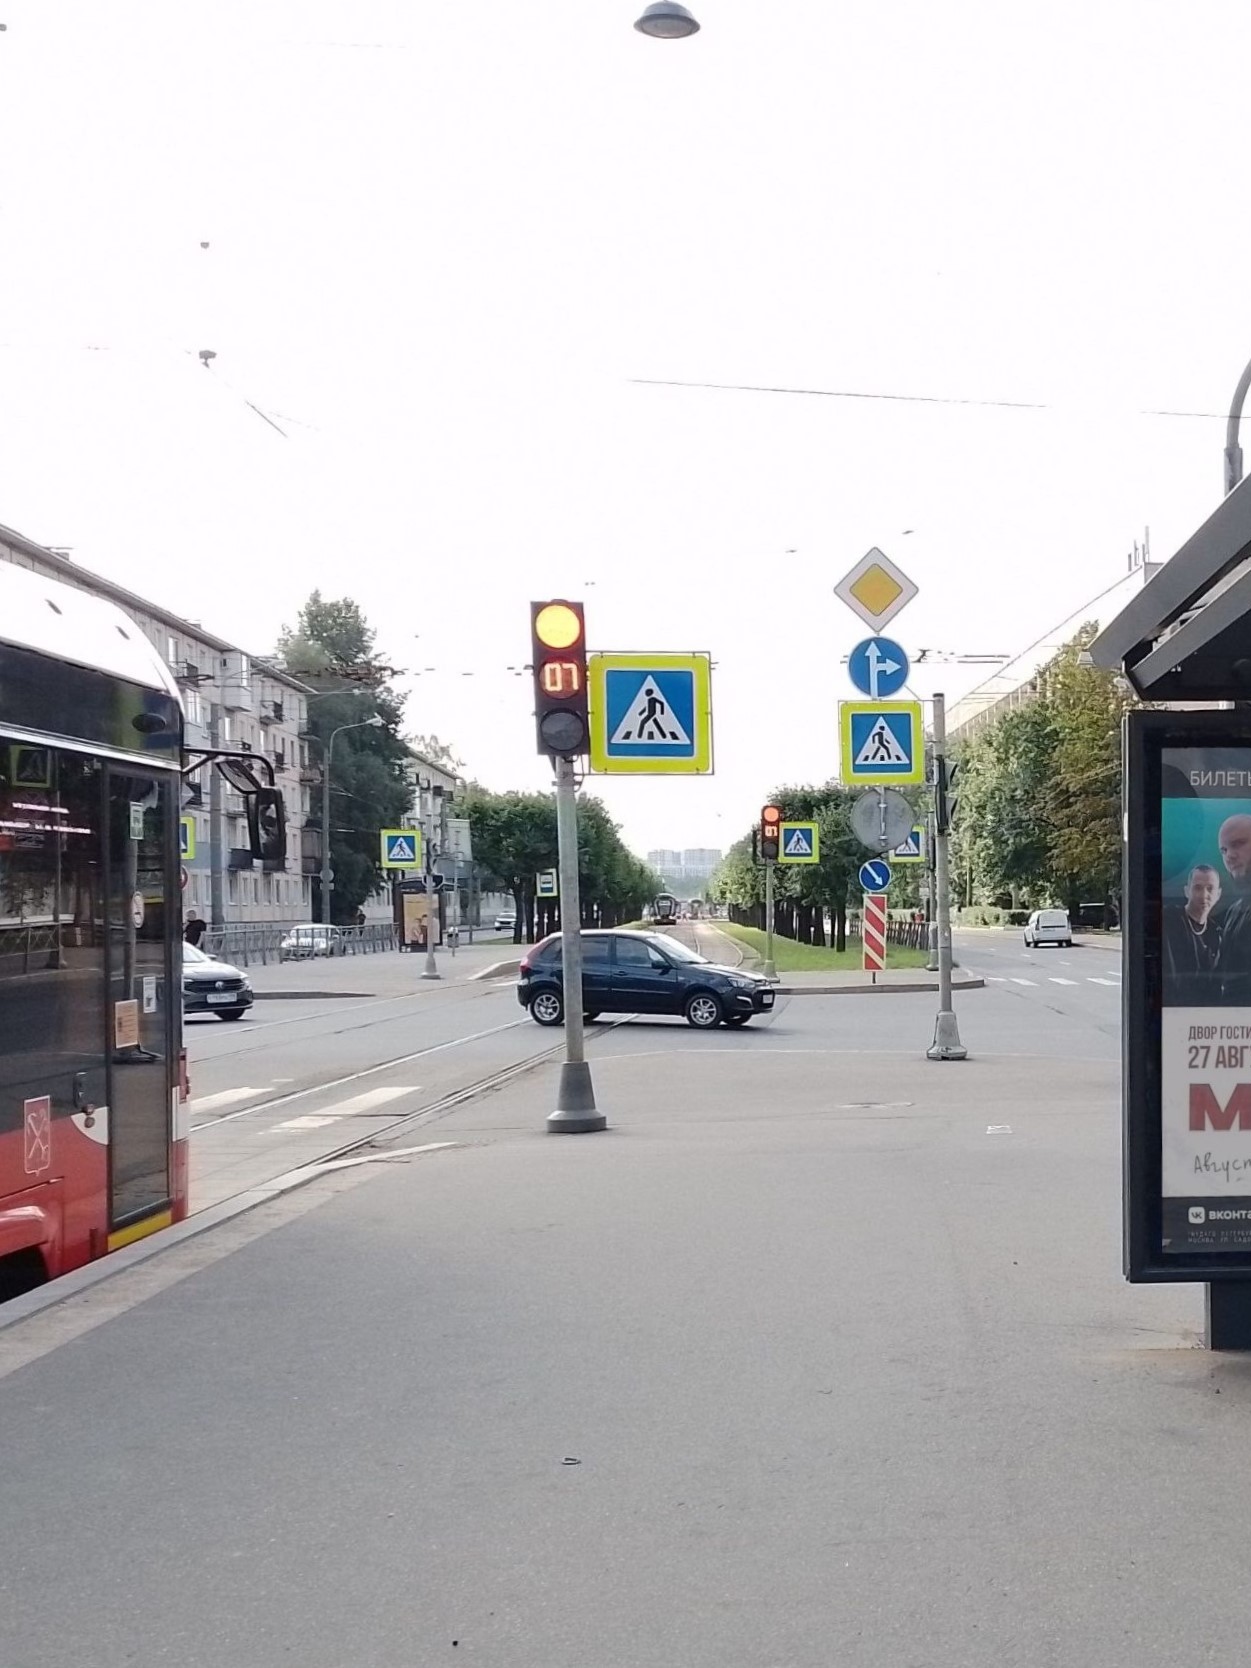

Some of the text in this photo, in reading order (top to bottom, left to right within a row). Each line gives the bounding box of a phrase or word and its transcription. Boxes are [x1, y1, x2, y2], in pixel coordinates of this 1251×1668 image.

[544, 662, 579, 691] 07
[1188, 1026, 1218, 1041] ДВОР
[1188, 1046, 1211, 1069] 27
